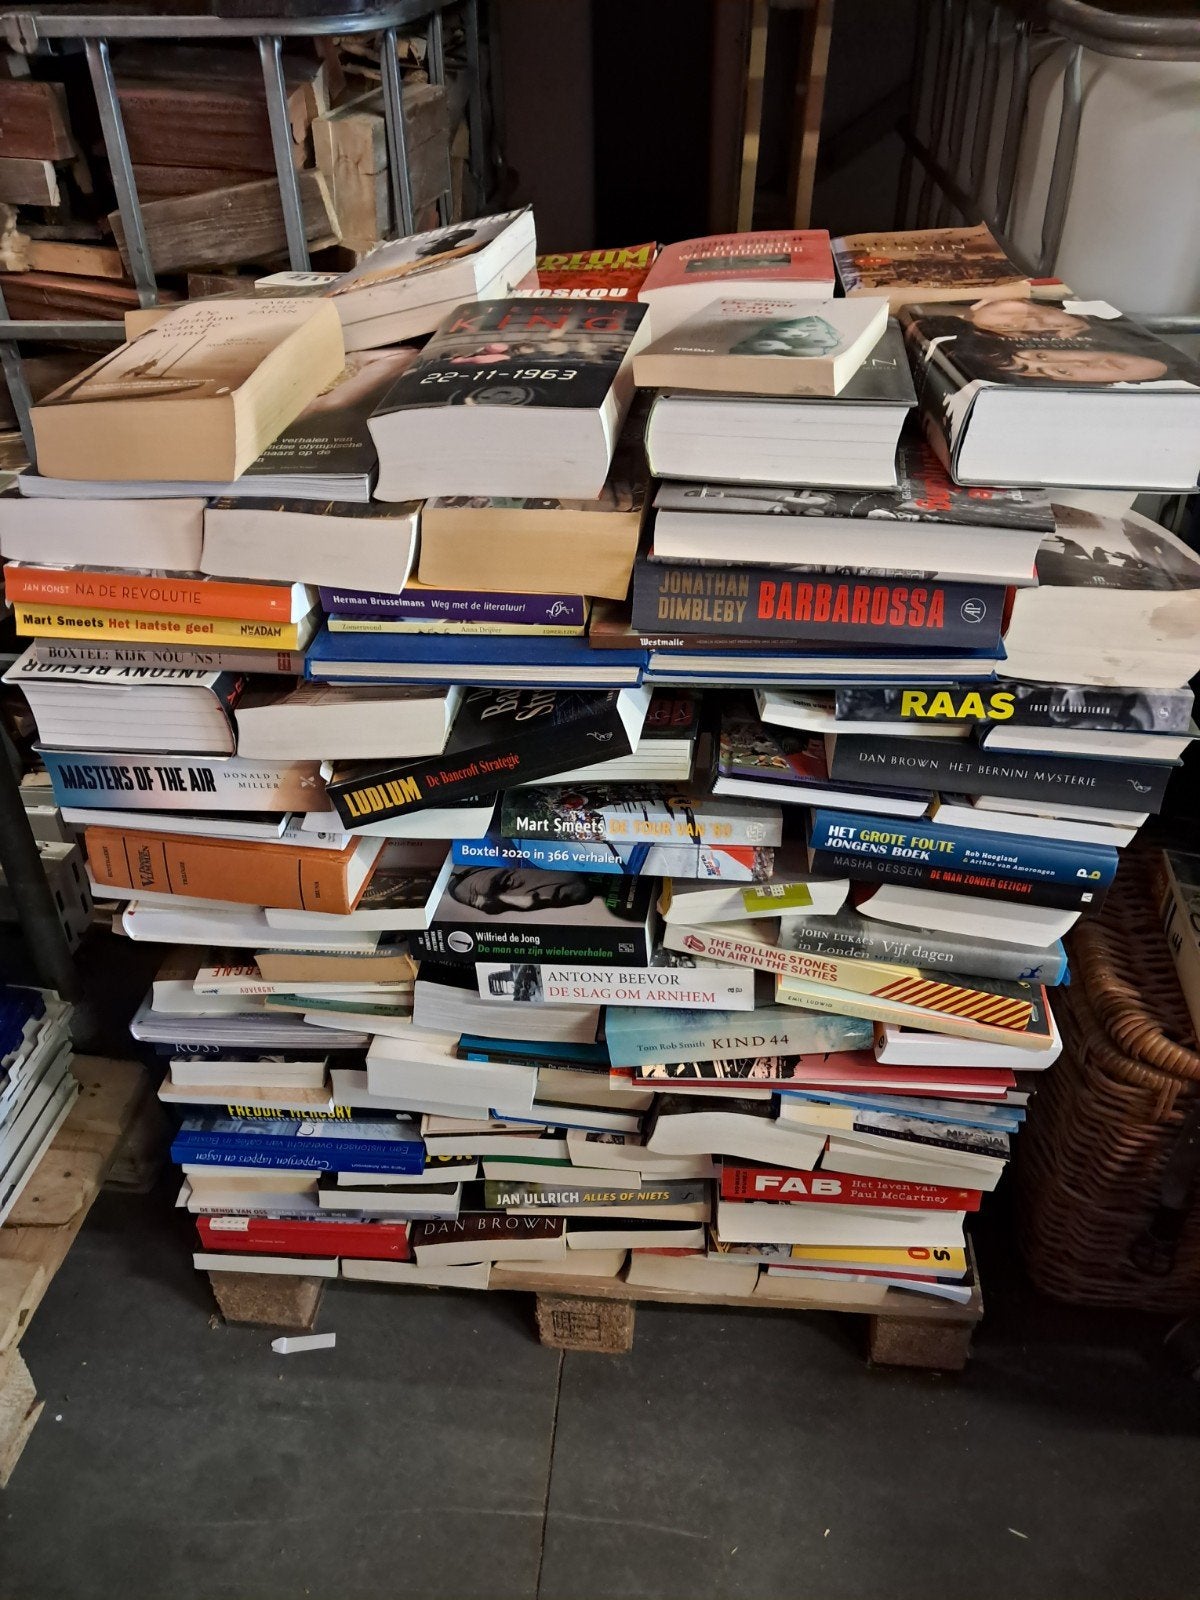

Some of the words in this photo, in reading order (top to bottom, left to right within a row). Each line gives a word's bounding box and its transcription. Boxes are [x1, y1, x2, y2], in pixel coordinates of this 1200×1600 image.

[449, 312, 621, 334] KING
[419, 368, 578, 385] 22-11-1963
[22, 582, 40, 593] JAN
[41, 583, 70, 595] KONST
[74, 583, 95, 597] NA
[99, 585, 117, 599] DE
[121, 586, 202, 605] REVOLUTIE
[657, 569, 750, 598] JONATHAN
[332, 595, 368, 605] Herman
[370, 597, 426, 608] Brusselmans
[431, 600, 450, 611] Weg
[452, 601, 469, 610] met
[471, 601, 482, 610] de
[484, 602, 527, 612] literatuur!
[657, 596, 748, 624] DIMBLEBY
[757, 581, 945, 629] BARBAROSSA
[22, 612, 53, 626] Mart
[57, 614, 105, 629] Smeets
[108, 617, 130, 630] Het
[134, 618, 181, 632] laatste
[185, 621, 214, 635] geel
[639, 637, 685, 647] Westmalle
[114, 648, 147, 662] KIJK
[901, 689, 1016, 720] RAAS
[1029, 703, 1048, 713] FRED
[57, 764, 134, 791] MASTERS
[137, 766, 154, 791] OF
[154, 766, 188, 792] THE
[190, 767, 217, 793] AIR
[223, 772, 271, 780] DONALD
[425, 773, 440, 788] De
[439, 764, 480, 784] Bancroft
[480, 752, 521, 777] Strategie
[859, 751, 887, 765] DAN
[890, 754, 939, 770] BROWN
[949, 761, 971, 774] HET
[978, 763, 1030, 780] BERNINI
[1033, 770, 1097, 788] MYSTERIE
[343, 775, 423, 818] LUDLUM
[516, 816, 549, 832] Mart
[553, 817, 604, 834] Smeets
[608, 818, 627, 835] DE
[633, 820, 671, 836] TOUR
[675, 822, 705, 838] VAN
[824, 837, 888, 855] JONGENS
[891, 846, 931, 862] BOEK
[828, 825, 858, 839] HET
[859, 829, 906, 847] GROTE
[910, 836, 957, 854] FOUTE
[461, 844, 500, 857] Boxtel
[501, 849, 531, 860] 2020
[533, 847, 545, 860] in
[547, 849, 569, 862] 366
[571, 850, 623, 864] verhalen
[964, 849, 980, 858] Rob
[981, 851, 1019, 863] Hoogland
[969, 858, 996, 868] Arthur
[997, 862, 1012, 870] van
[833, 855, 873, 870] MASHA
[876, 862, 923, 878] GESSEN
[929, 869, 941, 880] DE
[942, 871, 962, 884] MAN
[964, 873, 996, 888] ZONDER
[997, 878, 1034, 894] GEZICHT
[475, 931, 508, 943] Wilfried
[509, 932, 520, 942] de
[520, 932, 541, 945] Jong
[800, 928, 829, 939] JOHN
[833, 933, 874, 946] LUKACS
[881, 940, 911, 958] Vijf
[911, 945, 955, 963] dagen
[477, 944, 490, 954] De
[492, 946, 512, 954] man
[514, 947, 526, 955] en
[527, 946, 543, 957] zijn
[545, 946, 614, 958] wielerverhalen
[709, 937, 732, 950] THE
[734, 943, 786, 962] ROLLING
[787, 954, 839, 973] STONES
[798, 940, 811, 951] in
[816, 942, 871, 959] Londen
[706, 947, 726, 959] ON
[729, 952, 748, 964] AIR
[749, 956, 760, 967] IN
[761, 958, 788, 974] THE
[789, 963, 839, 982] SIXTIES
[547, 970, 617, 984] ANTONY
[618, 972, 681, 986] BEEVOR
[549, 986, 570, 998] DE
[572, 987, 614, 999] SLAG
[616, 989, 642, 1000] OM
[646, 990, 717, 1003] ARNHEM
[787, 995, 803, 1003] EMIL
[806, 1000, 833, 1008] LUDWIG
[636, 1043, 658, 1053] Tom
[659, 1041, 677, 1051] Rob
[678, 1039, 706, 1050] Smith
[711, 1035, 766, 1050] KIND
[769, 1033, 790, 1045] 44
[755, 1174, 843, 1196] FAB
[852, 1179, 874, 1190] Het
[877, 1180, 911, 1191] leven
[914, 1184, 938, 1193] van
[496, 1192, 521, 1206] JAN
[523, 1191, 580, 1205] ULLRICH
[582, 1192, 617, 1202] ALLES
[619, 1191, 636, 1201] OF
[637, 1191, 670, 1201] NIETS
[850, 1189, 879, 1200] Paul
[881, 1191, 949, 1204] McCartney
[423, 1218, 465, 1236] DAN
[477, 1216, 558, 1233] BROWN
